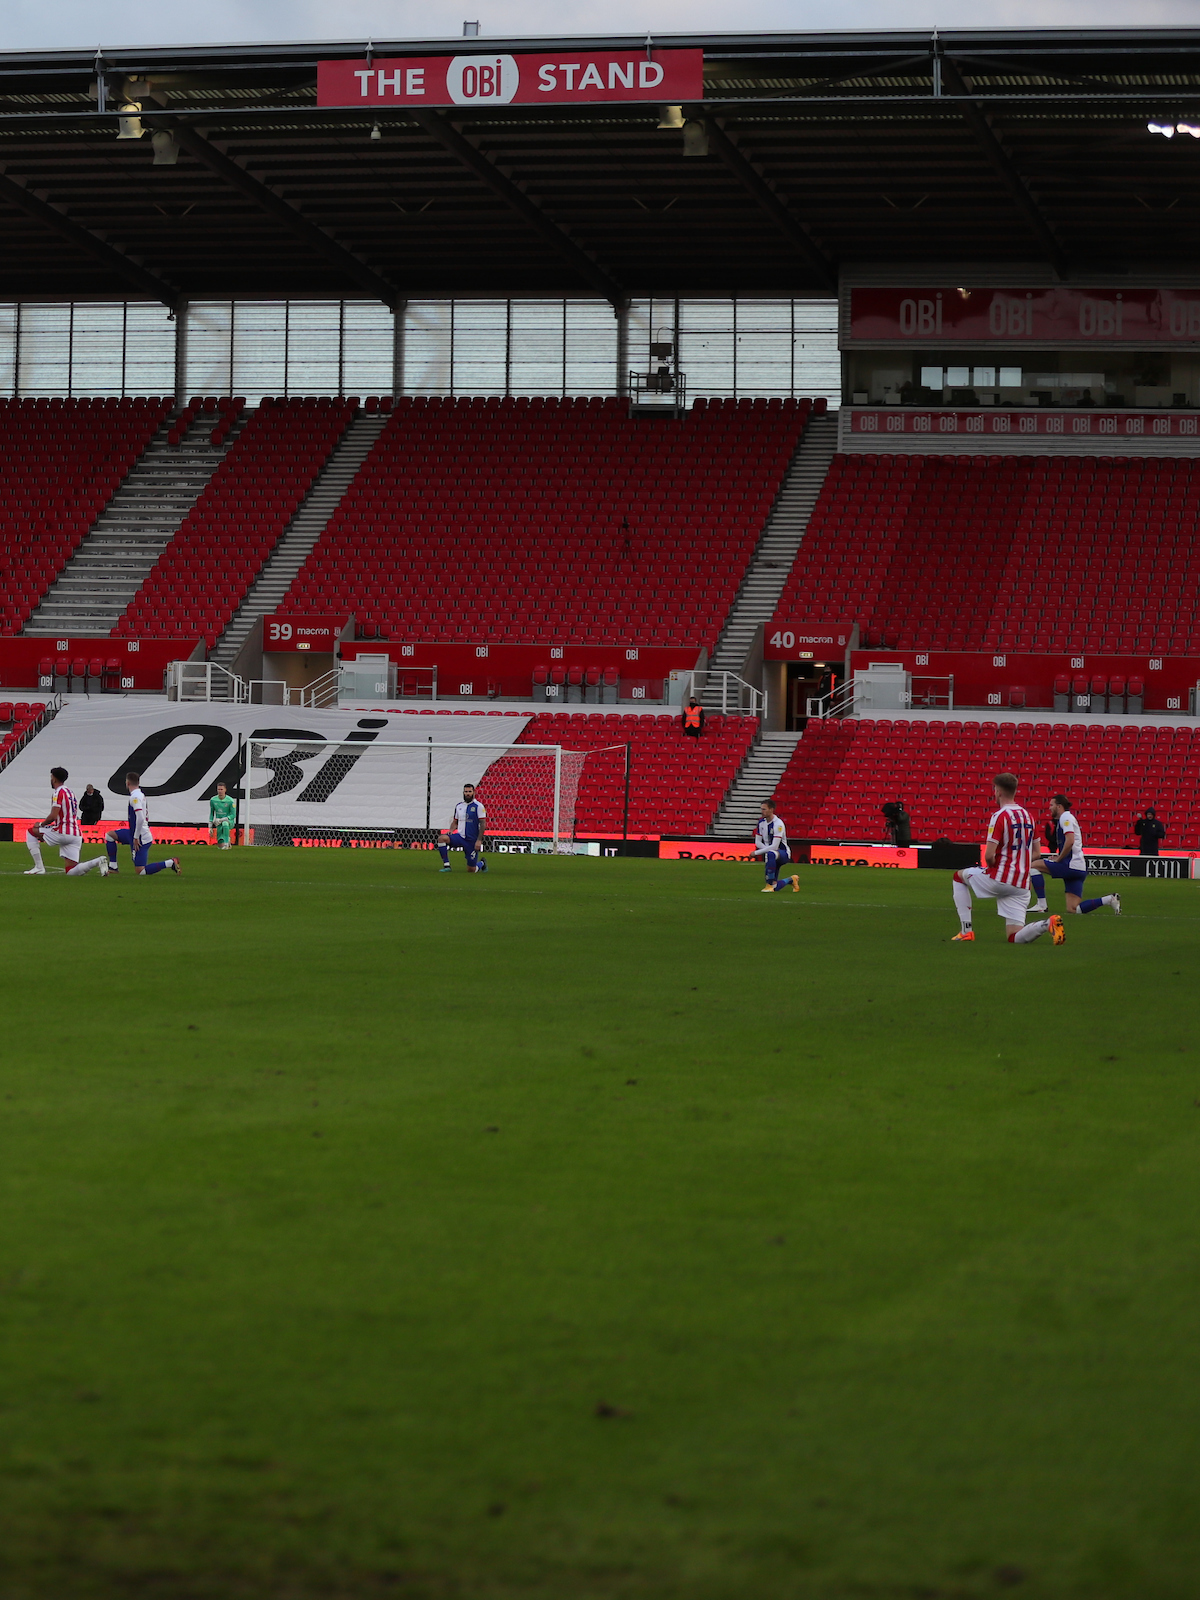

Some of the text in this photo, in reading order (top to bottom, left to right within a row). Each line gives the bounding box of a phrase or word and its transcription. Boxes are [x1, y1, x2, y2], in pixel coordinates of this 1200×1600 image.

[354, 68, 425, 97] THE
[537, 61, 665, 92] STAND
[1170, 301, 1200, 336] OB
[269, 623, 330, 640] 39 macron
[769, 631, 833, 648] 40 macron
[1011, 823, 1033, 850] 37
[604, 847, 618, 857] IT
